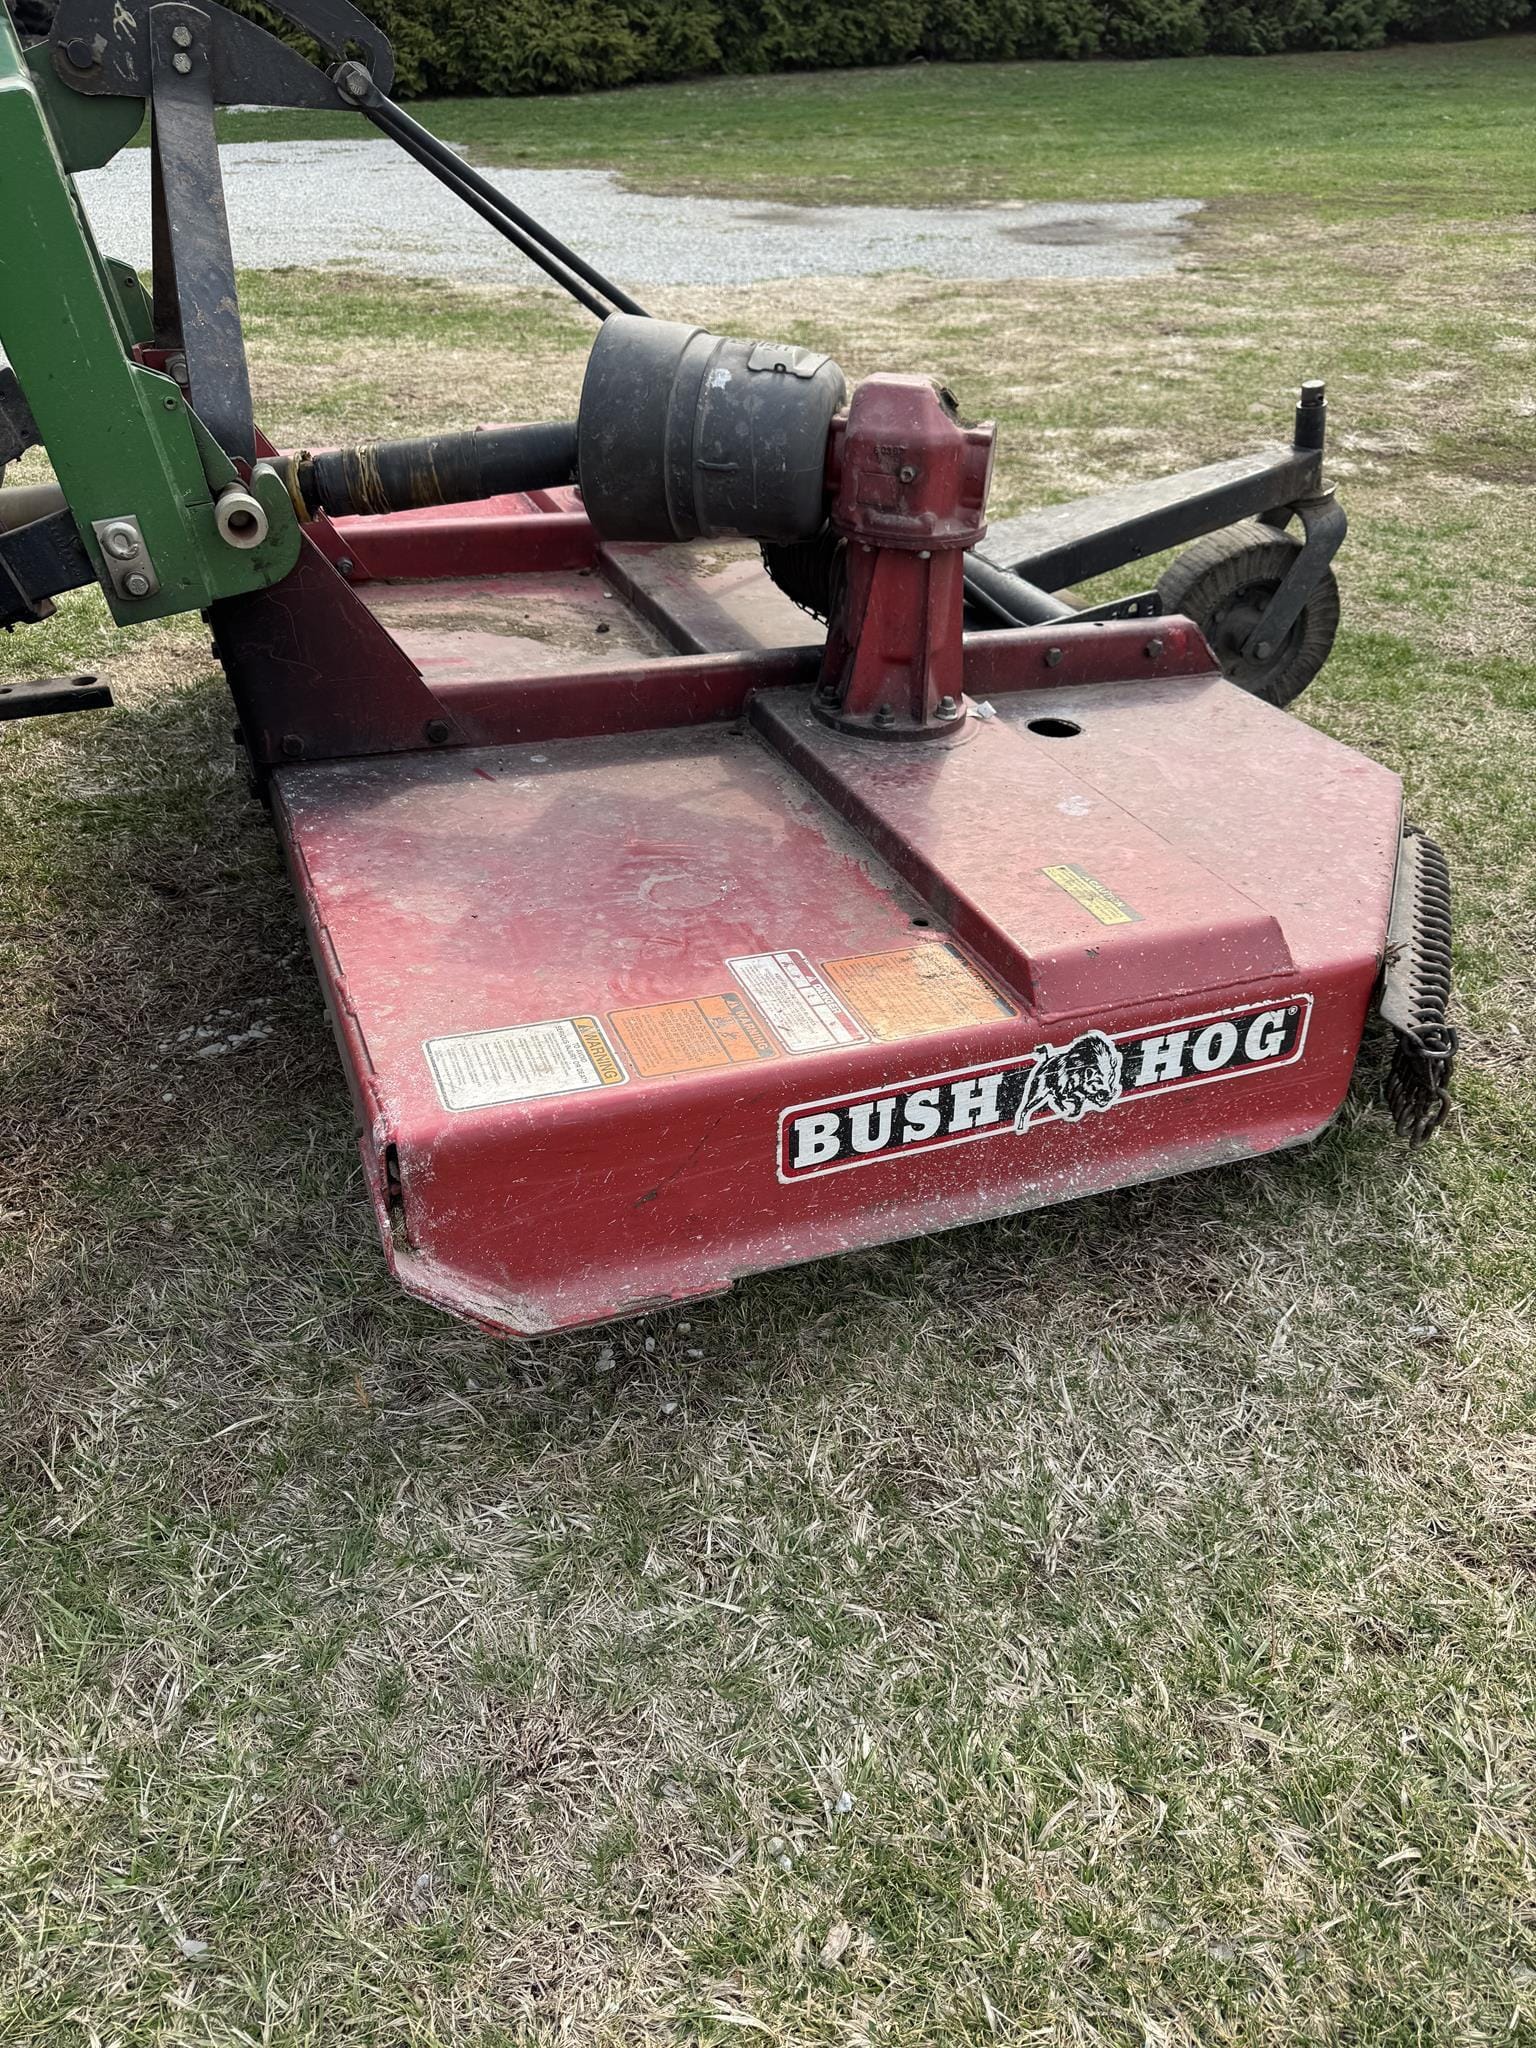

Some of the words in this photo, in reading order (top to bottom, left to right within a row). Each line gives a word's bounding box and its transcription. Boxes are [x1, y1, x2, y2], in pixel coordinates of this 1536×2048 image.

[1087, 879, 1126, 907] CAUTION
[811, 983, 843, 1014] DANGER
[733, 1009, 769, 1050] WARNING
[582, 1032, 618, 1080] WARNING
[794, 1073, 1001, 1168] BUSH
